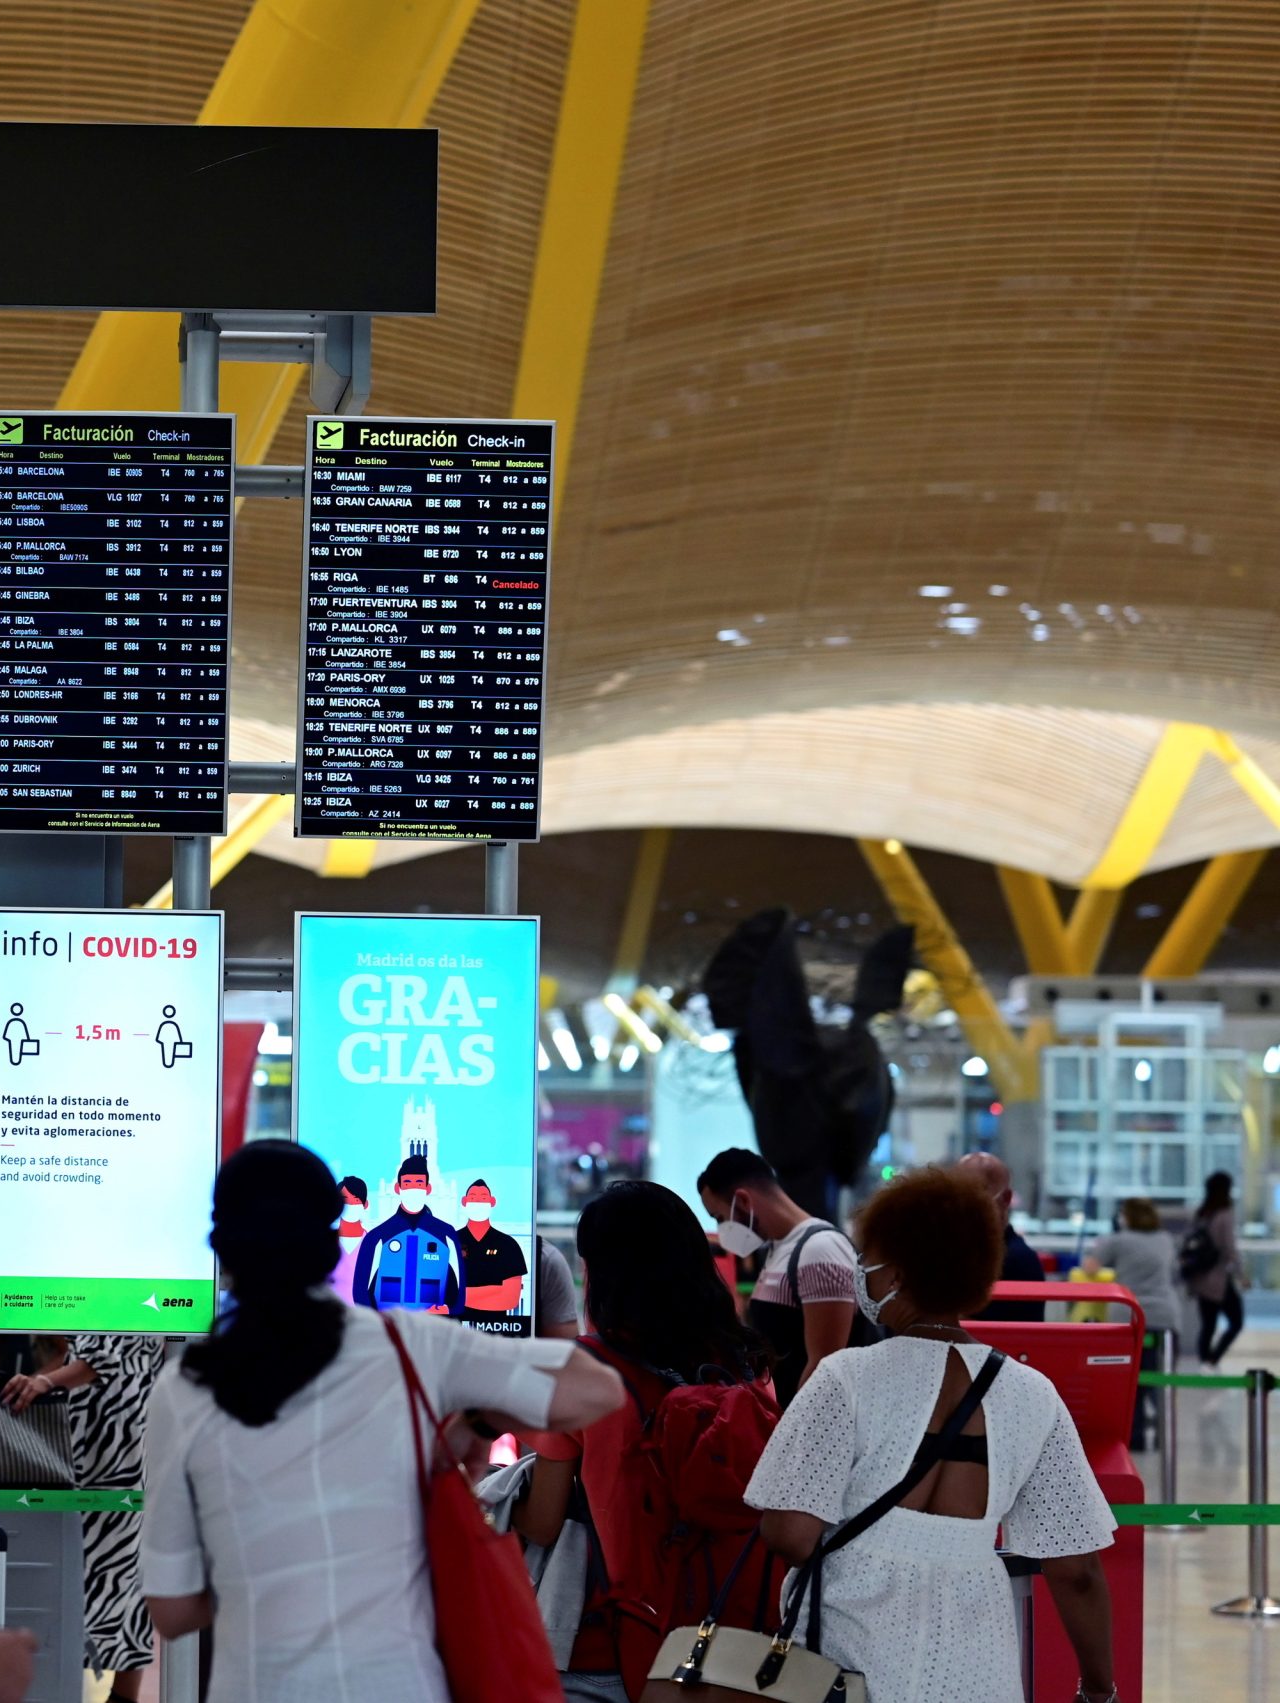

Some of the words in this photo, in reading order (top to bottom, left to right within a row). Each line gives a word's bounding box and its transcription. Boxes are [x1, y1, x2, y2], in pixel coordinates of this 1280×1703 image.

[43, 424, 133, 442] Facturación
[148, 430, 189, 442] Check-in
[360, 429, 457, 447] Facturación
[468, 435, 525, 448] Check-in
[355, 457, 387, 465] Destino
[506, 460, 543, 468] Mostradores
[18, 467, 64, 475] BARCELONA
[337, 472, 365, 481] MIAMI
[17, 492, 64, 500] BARCELONA
[336, 497, 365, 506] GRAN
[368, 498, 412, 507] CANARIA
[17, 518, 44, 527] LISBOA
[335, 523, 383, 533] TENERIFE
[385, 524, 419, 533] NORTE
[16, 542, 66, 550] P.MALLORCA
[334, 548, 362, 557] LYON
[16, 567, 44, 575] BILBAO
[334, 573, 358, 581] RIGA
[493, 580, 539, 589] Cancelado
[16, 591, 49, 600] GINEBRA
[332, 598, 417, 608] FUERTEVENTURA
[15, 617, 34, 625] IBIZA
[332, 623, 398, 632] P.MALLORCA
[15, 641, 25, 649] LA
[27, 641, 53, 650] PALMA
[331, 648, 392, 658] LANZAROTE
[15, 666, 47, 674] MALAGA
[330, 673, 385, 682] PARIS-ORY
[14, 690, 62, 699] LONDRES-HR
[330, 698, 380, 707] MENORCA
[14, 715, 58, 724] DUBROVNIK
[329, 723, 376, 732] TENERIFE
[379, 724, 412, 733] NORTE
[14, 740, 54, 748] PARIS-ORY
[328, 748, 393, 757] P.MALLORCA
[13, 764, 40, 773] ZURICH
[327, 773, 352, 781] IBIZA
[13, 789, 28, 797] SAN
[30, 789, 72, 798] SEBASTIAN
[326, 798, 351, 806] IBIZA
[3, 931, 58, 957] info
[83, 936, 197, 959] COVID-19
[357, 953, 413, 968] Madrid
[418, 957, 434, 968] os
[438, 954, 458, 968] da
[461, 956, 483, 969] las
[338, 974, 497, 1027] GRA-
[75, 1025, 102, 1041] 1,5
[106, 1028, 120, 1040] m
[337, 1032, 495, 1086] CIAS
[2, 1095, 44, 1105] Mantén
[48, 1096, 57, 1106] la
[61, 1096, 112, 1106] distancia
[116, 1096, 129, 1107] de
[2, 1110, 57, 1121] seguridad
[62, 1112, 75, 1120] en
[78, 1111, 104, 1121] todo
[108, 1112, 160, 1121] momento
[1, 1128, 7, 1137] y
[11, 1126, 40, 1136] evita
[44, 1127, 136, 1139] aglomeraciones.
[1, 1155, 26, 1167] Keep
[39, 1156, 61, 1166] safe
[64, 1156, 108, 1166] distance
[0, 1172, 19, 1182] and
[23, 1172, 50, 1182] avoid
[53, 1173, 103, 1185] crowding.
[162, 1297, 194, 1308] aena
[476, 1322, 522, 1331] MADRID
